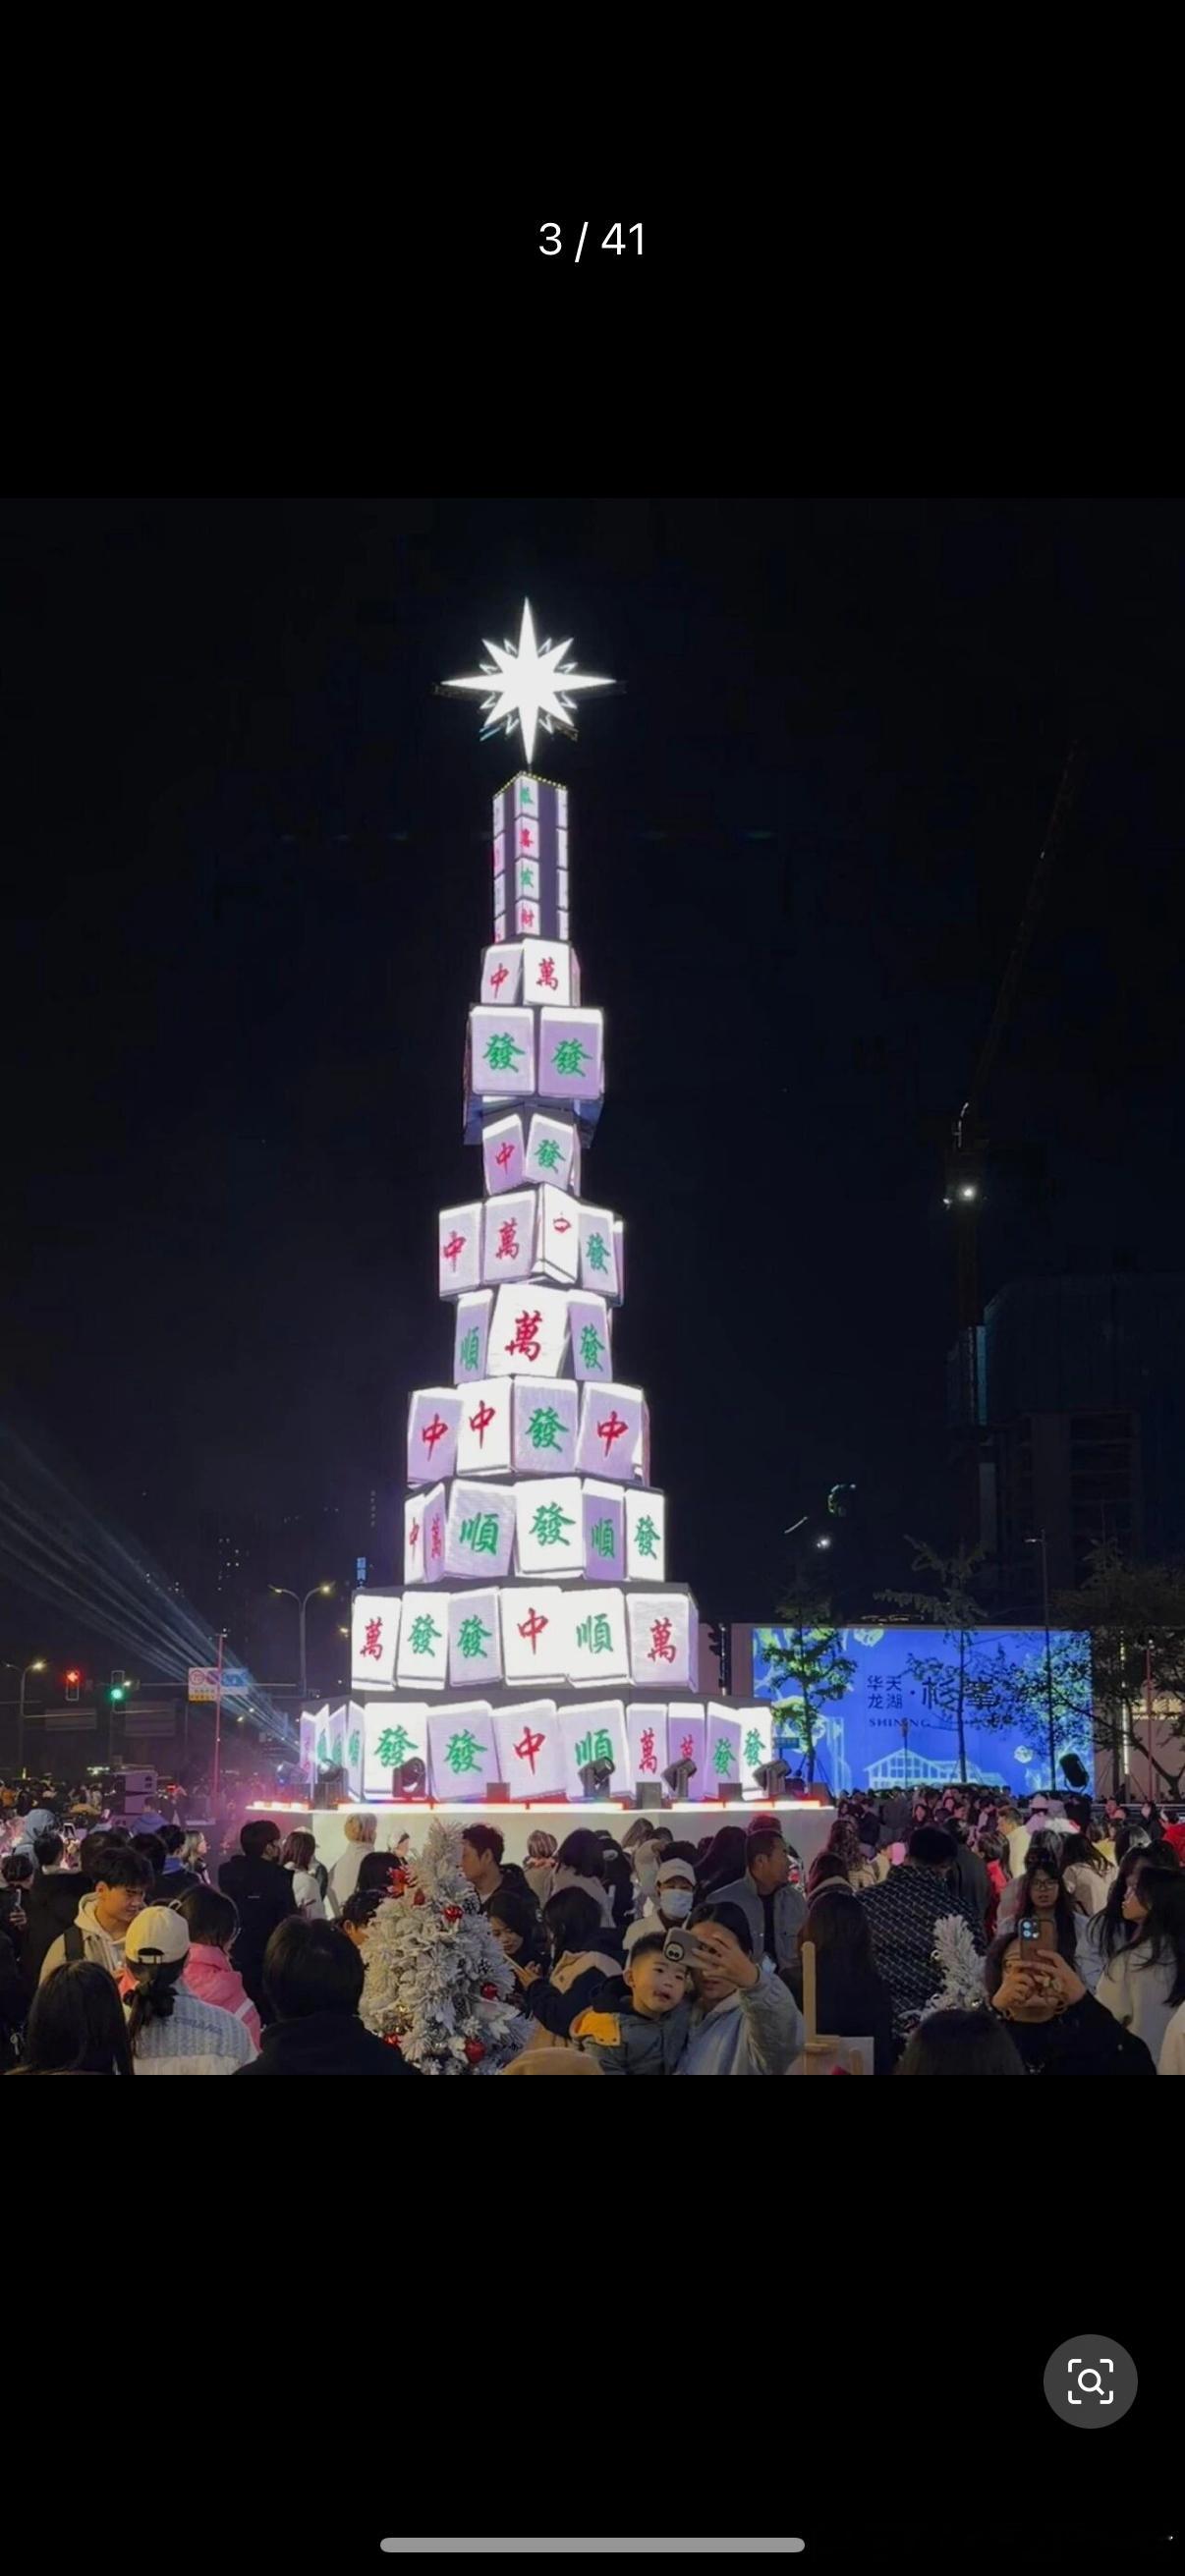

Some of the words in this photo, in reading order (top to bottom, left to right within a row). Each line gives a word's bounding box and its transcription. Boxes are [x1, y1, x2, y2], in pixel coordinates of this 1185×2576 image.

[491, 963, 509, 998] 中
[536, 957, 558, 990] 萬
[482, 1033, 525, 1073] 發
[550, 1038, 592, 1077] 發
[495, 1143, 514, 1174] 中
[535, 1140, 566, 1173] 發
[444, 1231, 466, 1271] 中
[496, 1217, 520, 1260] 萬
[587, 1232, 610, 1273] 發
[461, 1326, 479, 1371] 順
[505, 1310, 542, 1362] 萬
[580, 1323, 605, 1372] 發
[423, 1413, 449, 1462] 中
[470, 1400, 495, 1449] 中
[526, 1407, 569, 1452] 發
[597, 1411, 629, 1457] 中
[459, 1512, 499, 1555] 順
[529, 1502, 576, 1546] 發
[592, 1518, 615, 1558] 順
[634, 1516, 661, 1560] 發
[360, 1616, 383, 1660] 萬
[408, 1613, 442, 1657] 發
[458, 1614, 492, 1658] 發
[517, 1607, 548, 1654] 中
[577, 1613, 614, 1653] 順
[648, 1617, 677, 1663] 萬
[867, 1675, 902, 1691] 华天
[868, 1693, 903, 1709] 龙湖
[869, 1718, 931, 1728] SHINNG
[374, 1724, 419, 1768] 發
[444, 1729, 487, 1773] 發
[513, 1726, 545, 1775] 中
[639, 1727, 657, 1774] 萬
[713, 1737, 736, 1778] 發
[744, 1728, 765, 1767] 發
